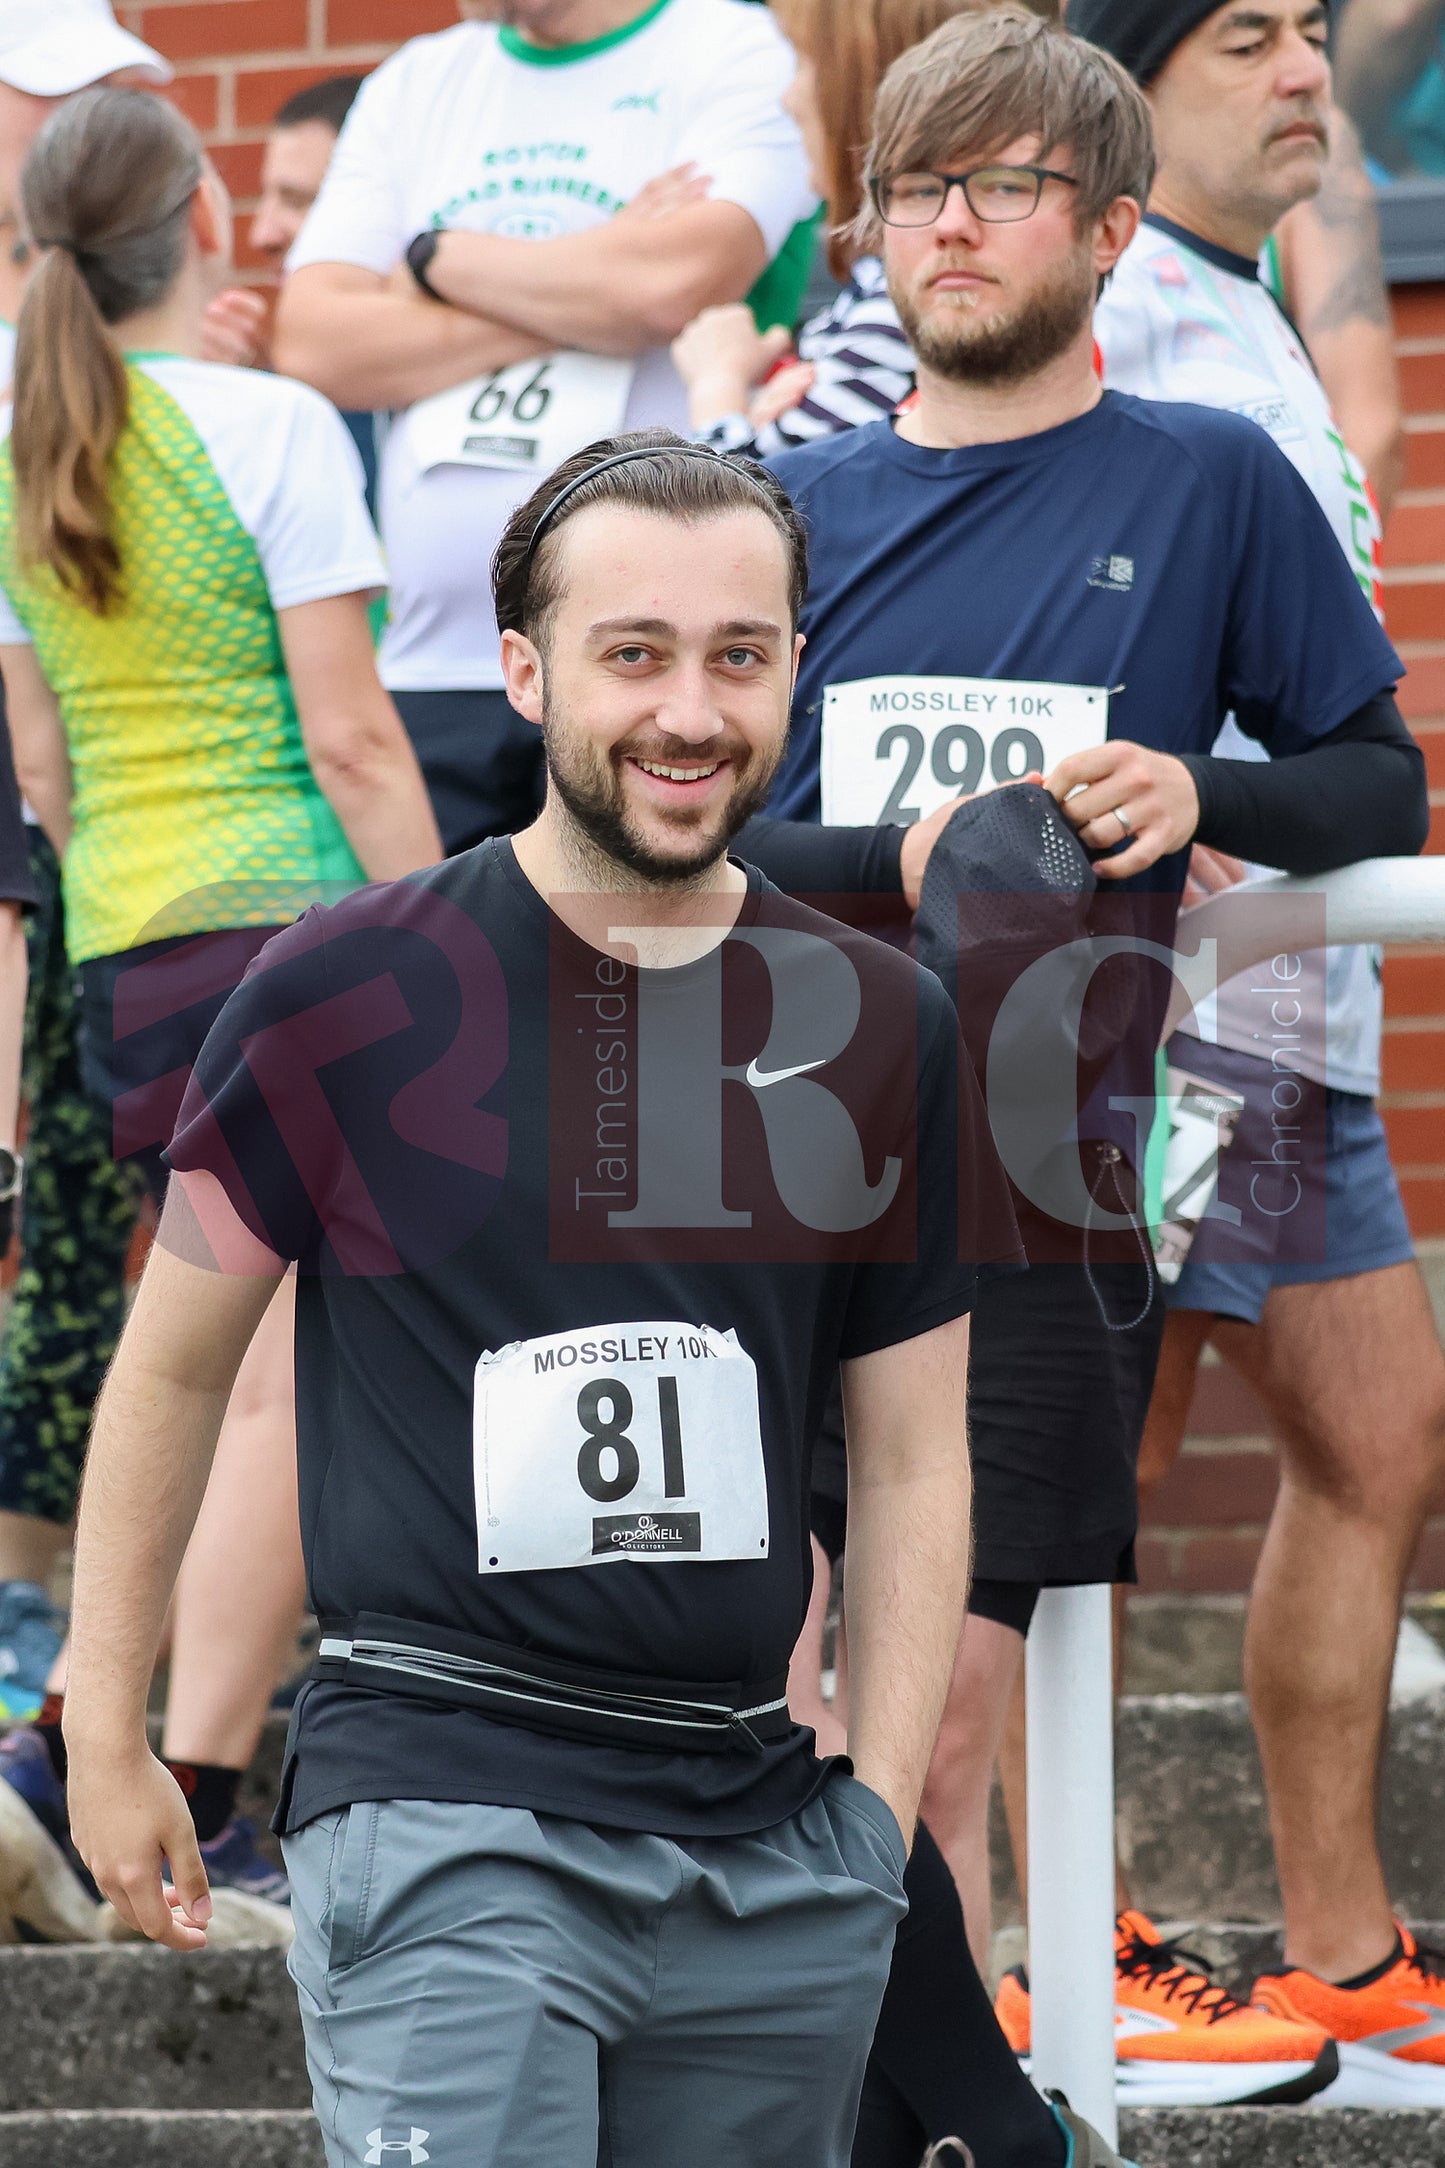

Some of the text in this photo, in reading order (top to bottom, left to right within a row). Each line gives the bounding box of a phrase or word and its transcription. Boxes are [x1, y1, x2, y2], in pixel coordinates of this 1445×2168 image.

[468, 364, 551, 423] 66
[869, 691, 1053, 717] MOSSLEY 10K
[534, 1336, 718, 1374] MOSSLEY 10K
[577, 1376, 686, 1503] 81
[611, 1528, 683, 1543] O'DONNELL
